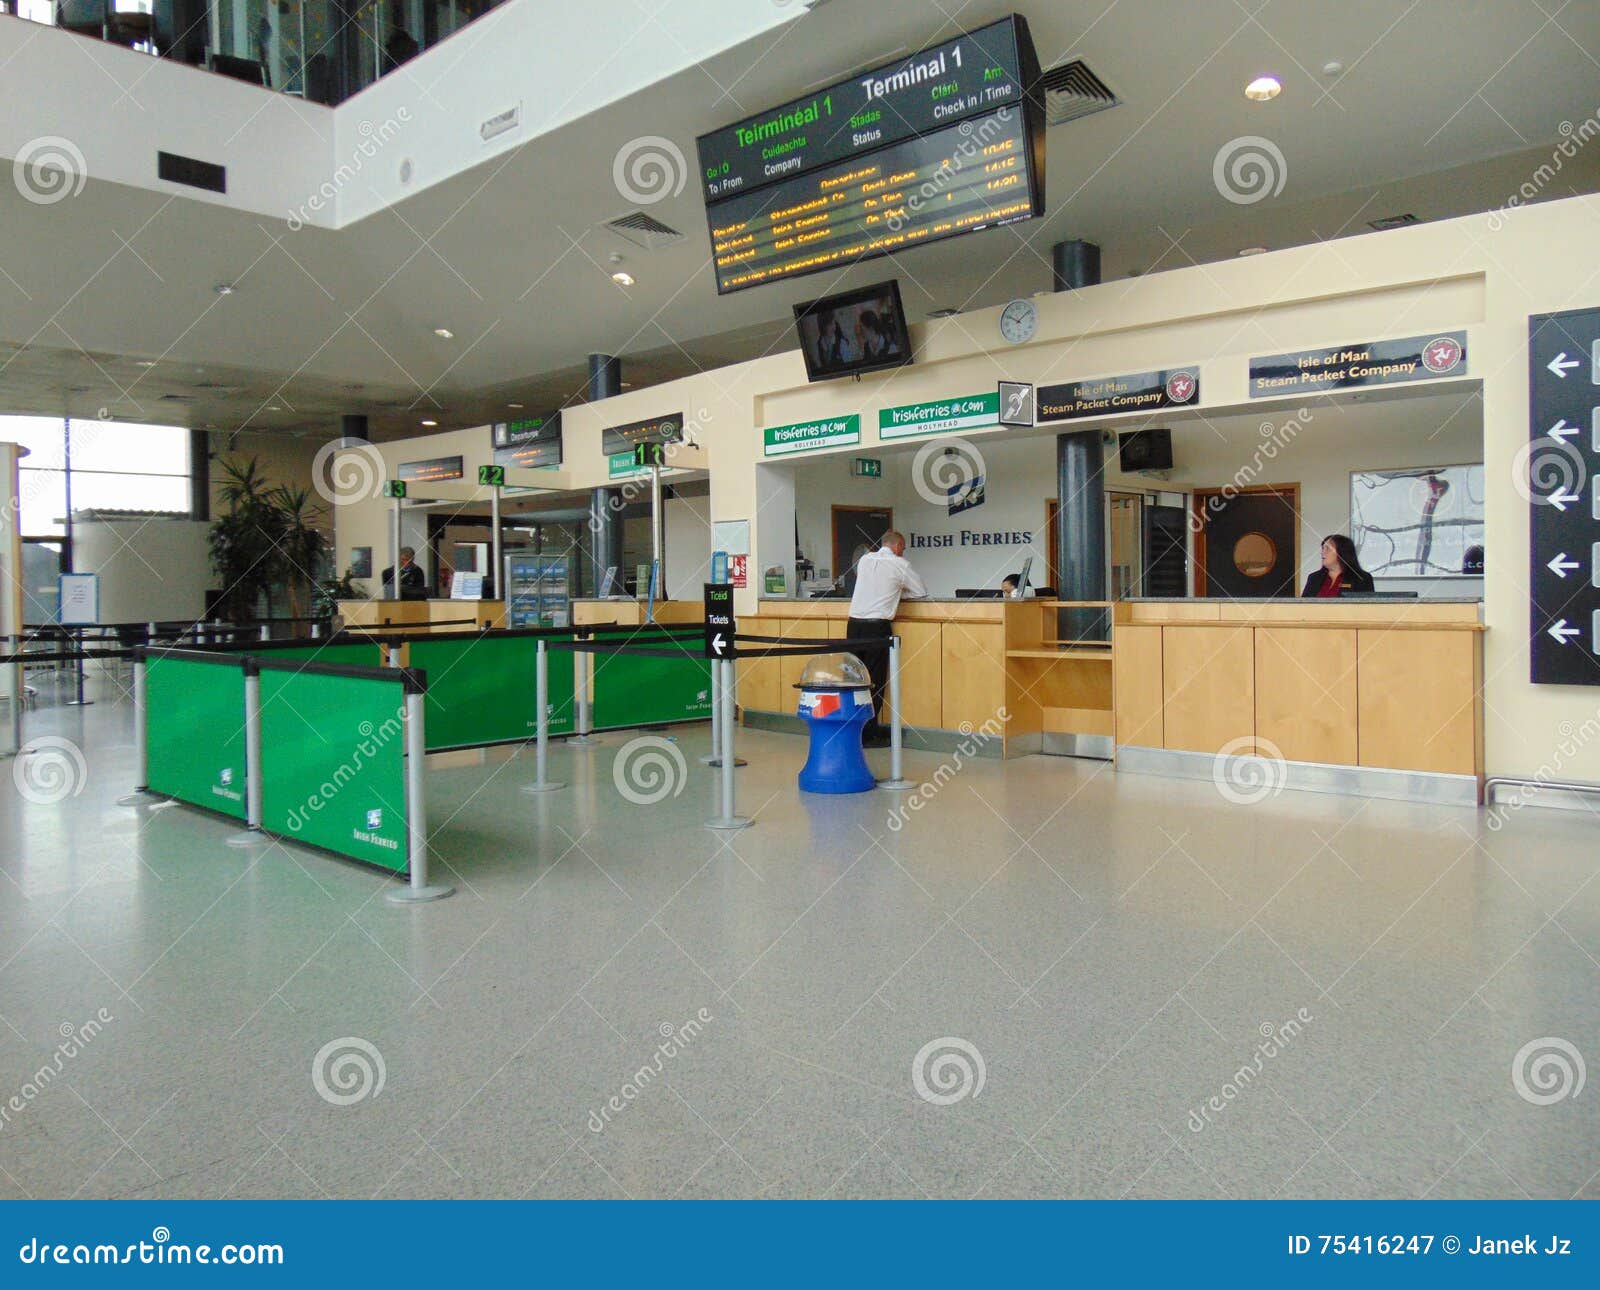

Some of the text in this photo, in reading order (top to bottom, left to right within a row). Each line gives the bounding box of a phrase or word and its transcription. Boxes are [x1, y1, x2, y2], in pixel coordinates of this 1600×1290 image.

[862, 45, 962, 101] Terminal 1
[934, 99, 966, 119] Check
[967, 94, 978, 108] in
[985, 83, 1012, 100] Time
[735, 95, 832, 148] Teirminéal 1
[850, 109, 881, 129] Stadas
[762, 135, 807, 160] Cuideachta
[852, 129, 882, 146] Status
[764, 156, 802, 176] Company
[708, 183, 719, 195] To
[722, 176, 743, 191] From
[1298, 350, 1370, 369] Isle of Man
[1256, 361, 1416, 389] Steam Packet Company
[1073, 382, 1128, 398] Isle of Man
[1042, 392, 1163, 415] Steam Packet Company
[917, 419, 959, 431] HOLYHEAD
[637, 443, 646, 465] 1
[479, 465, 489, 485] 2
[490, 465, 503, 484] 2
[394, 480, 405, 496] 3
[910, 530, 1033, 548] IRISH FERRIES
[708, 614, 729, 625] Tickets
